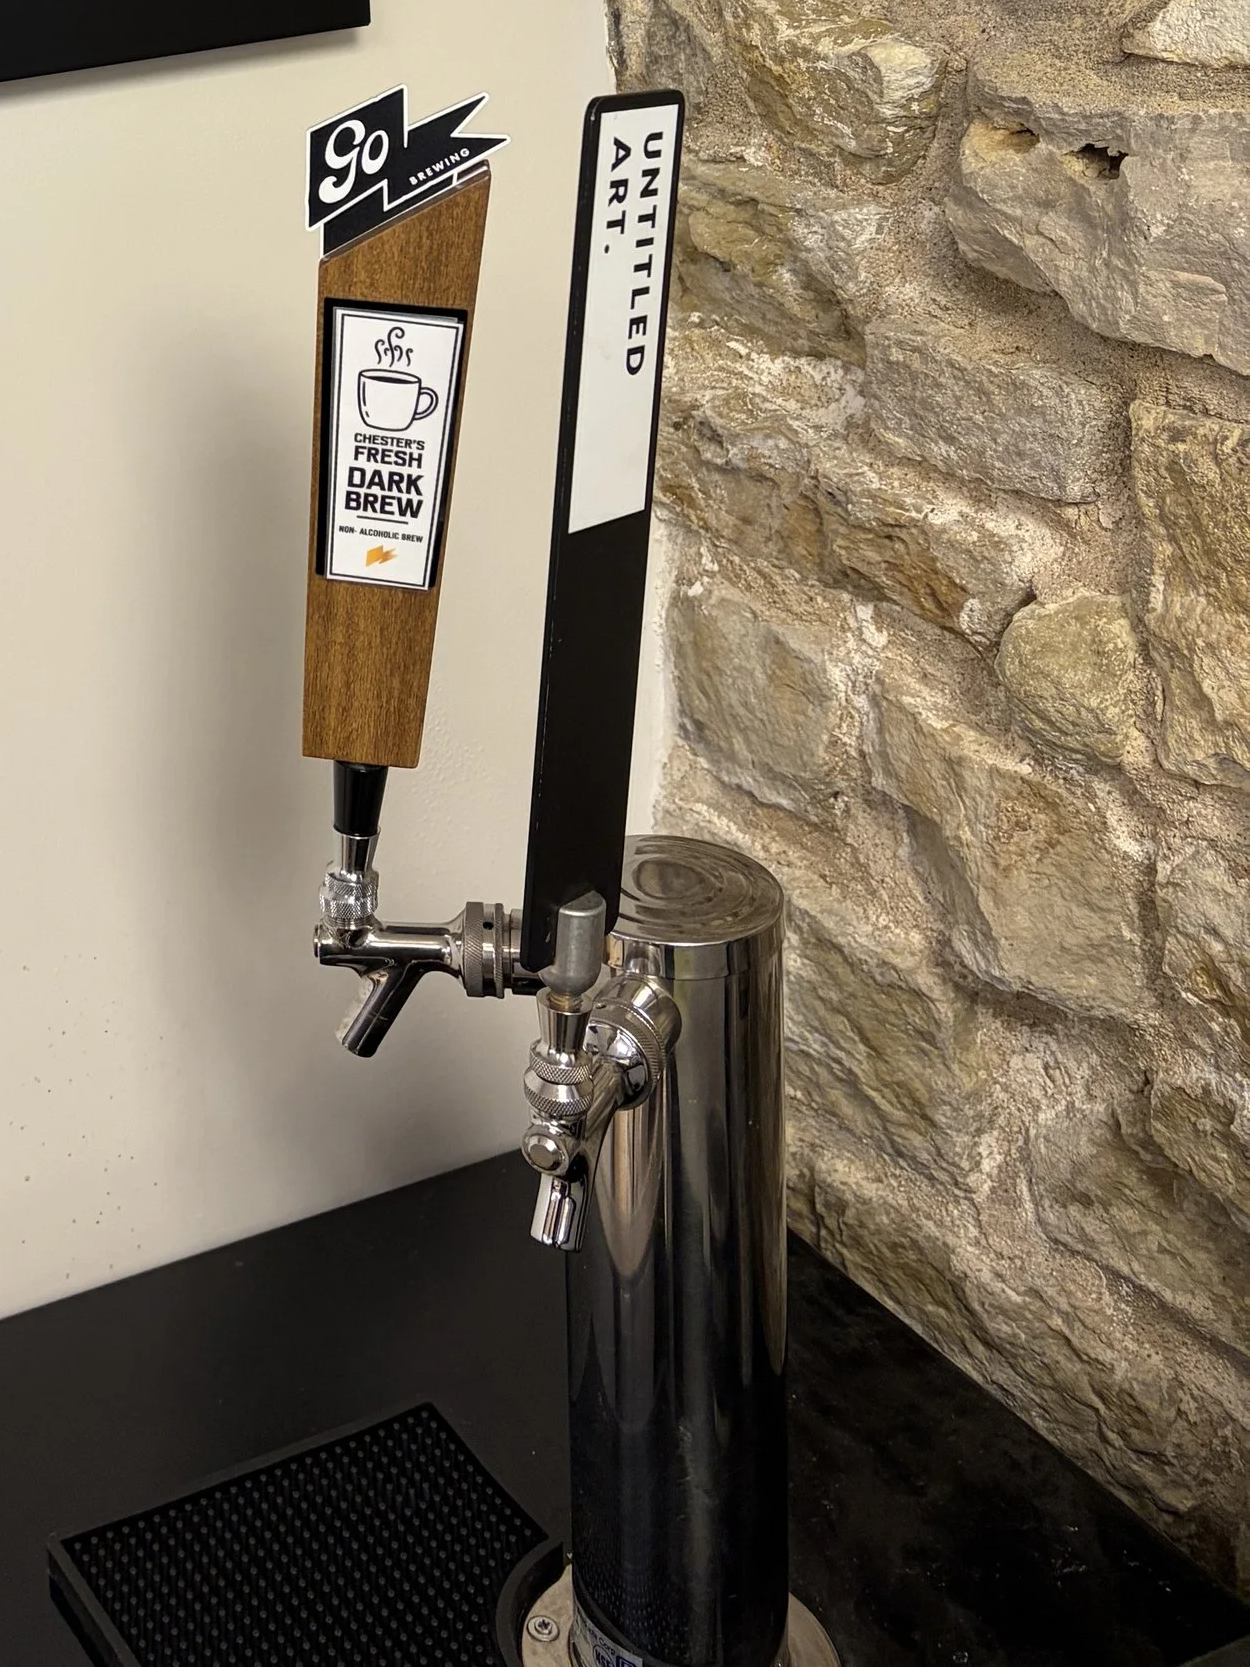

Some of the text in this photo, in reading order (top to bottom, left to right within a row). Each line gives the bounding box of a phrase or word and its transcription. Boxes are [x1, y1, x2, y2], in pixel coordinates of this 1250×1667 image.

[409, 147, 470, 185] BREWING
[604, 136, 632, 254] ART.
[625, 131, 664, 376] UNTITLED
[353, 432, 426, 451] CHESTER'S
[353, 445, 424, 469] FRESH
[347, 466, 425, 497] DARK
[344, 490, 424, 519] BREW
[359, 527, 400, 540] ALCOHOLIC
[401, 533, 424, 543] BREW
